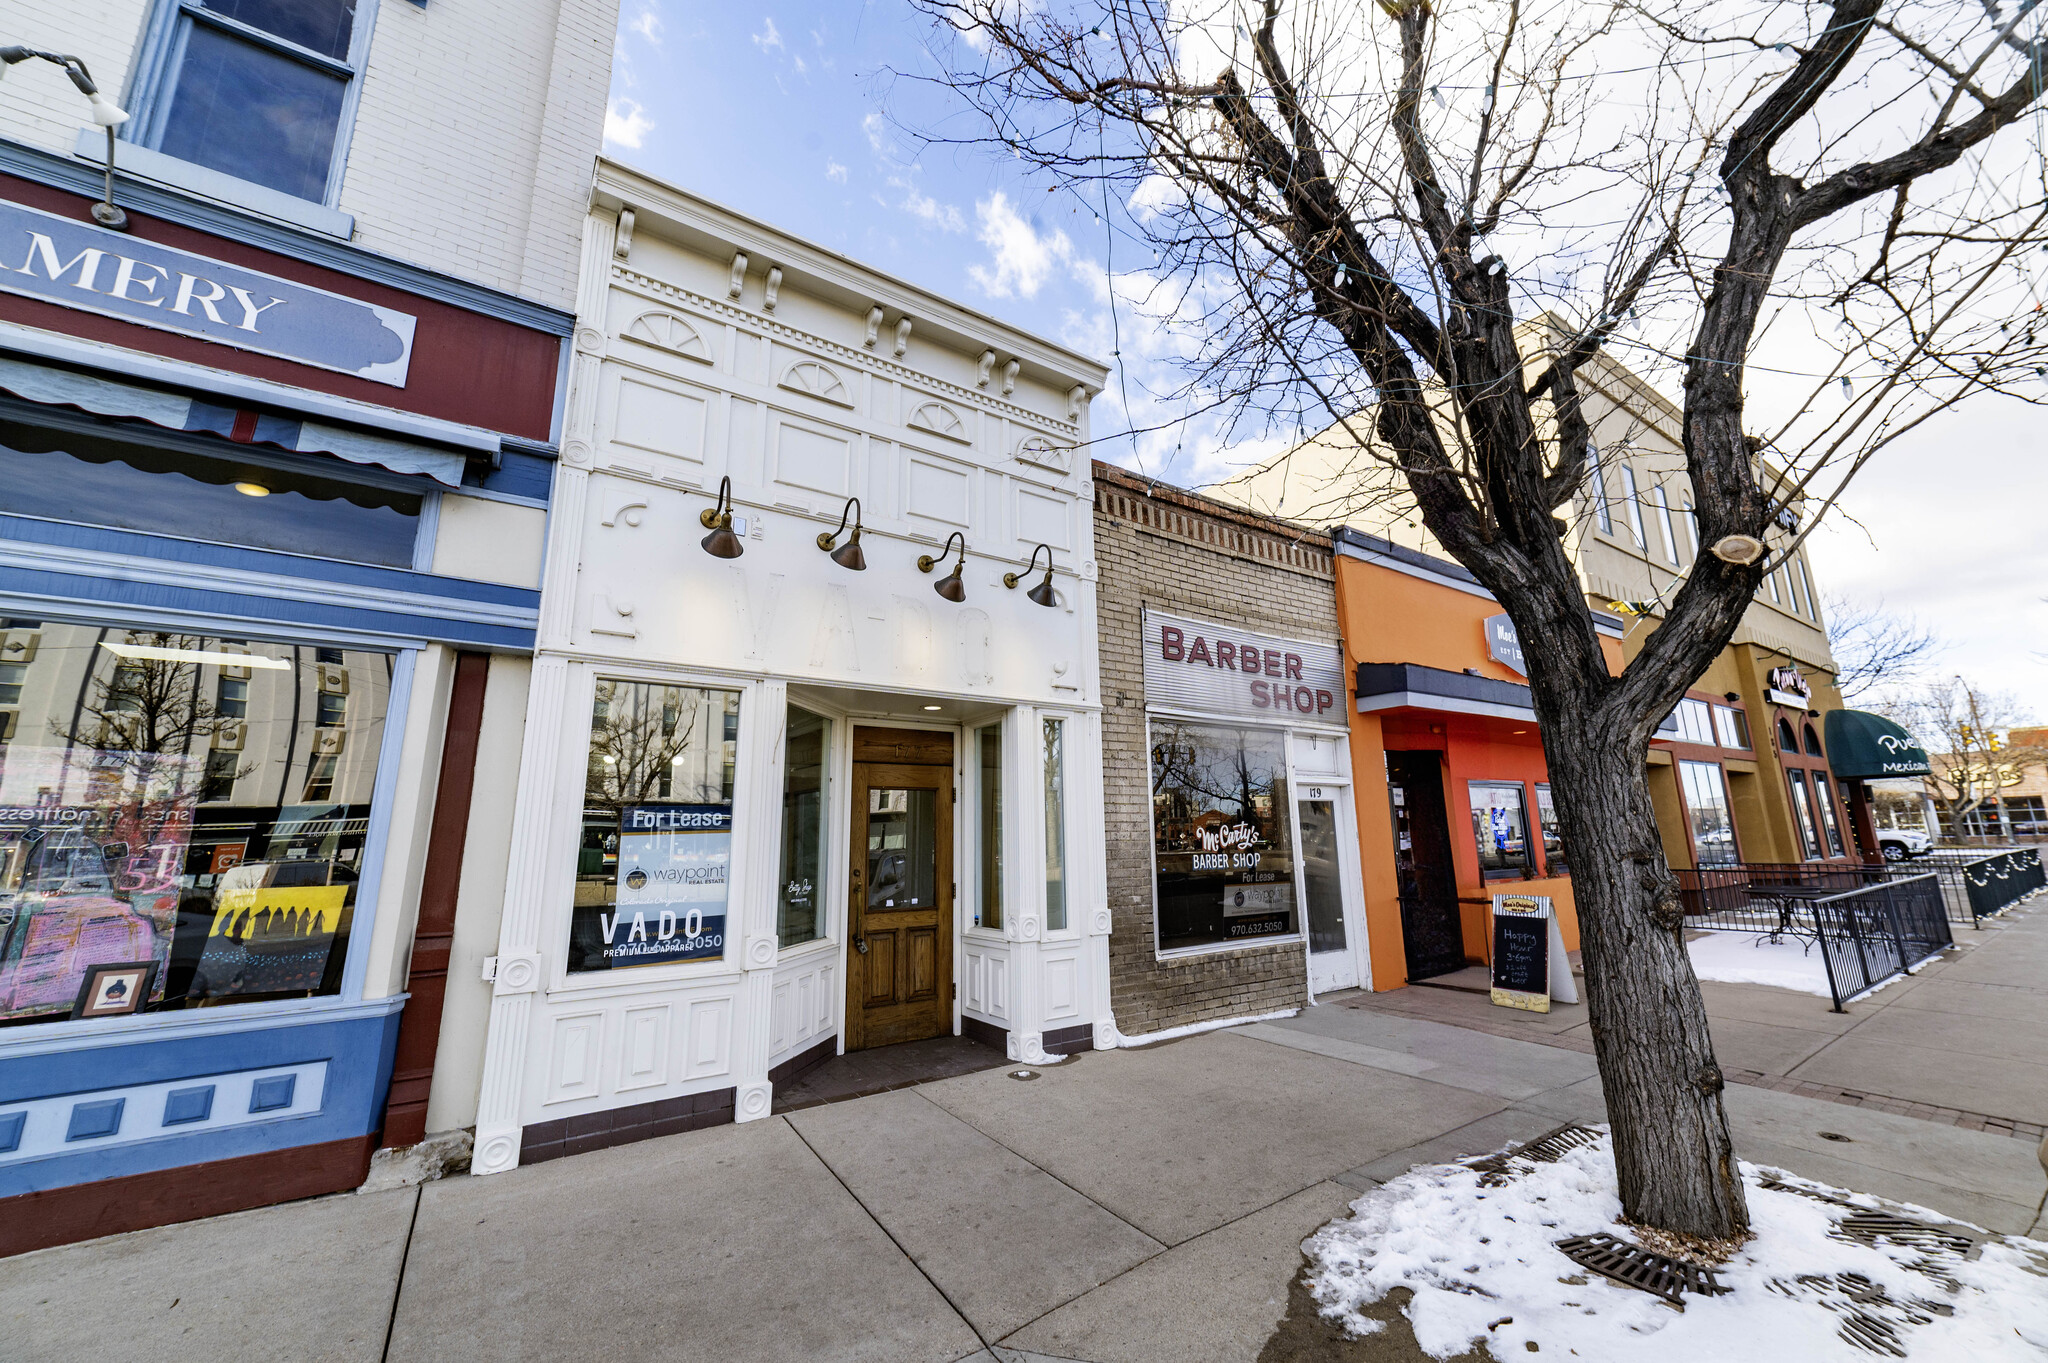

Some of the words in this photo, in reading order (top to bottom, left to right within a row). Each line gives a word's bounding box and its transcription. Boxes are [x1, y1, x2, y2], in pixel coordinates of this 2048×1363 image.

[0, 230, 288, 334] MERY
[1496, 624, 1516, 644] Moe's
[1162, 624, 1304, 681] BARBER
[1500, 647, 1511, 656] EST
[1250, 679, 1334, 715] SHOP
[1877, 734, 1918, 755] Pue
[1309, 787, 1322, 799] 179
[633, 809, 664, 828] For
[669, 809, 723, 828] Lease
[1196, 820, 1260, 852] McCarty's
[1192, 853, 1229, 870] BARBER
[1232, 852, 1261, 868] SHOP
[654, 864, 725, 884] waypoint
[1242, 872, 1254, 883] For
[1255, 872, 1275, 882] Lease
[619, 896, 655, 906] Colorado
[654, 895, 688, 907] Original
[600, 908, 703, 945] VADO
[1230, 921, 1283, 936] 970.632.5050
[617, 934, 723, 954] 9706325050
[1504, 929, 1536, 946] Happy
[603, 946, 641, 958] PREMIUM
[659, 943, 694, 954] APPAREL
[1511, 943, 1533, 952] Hour
